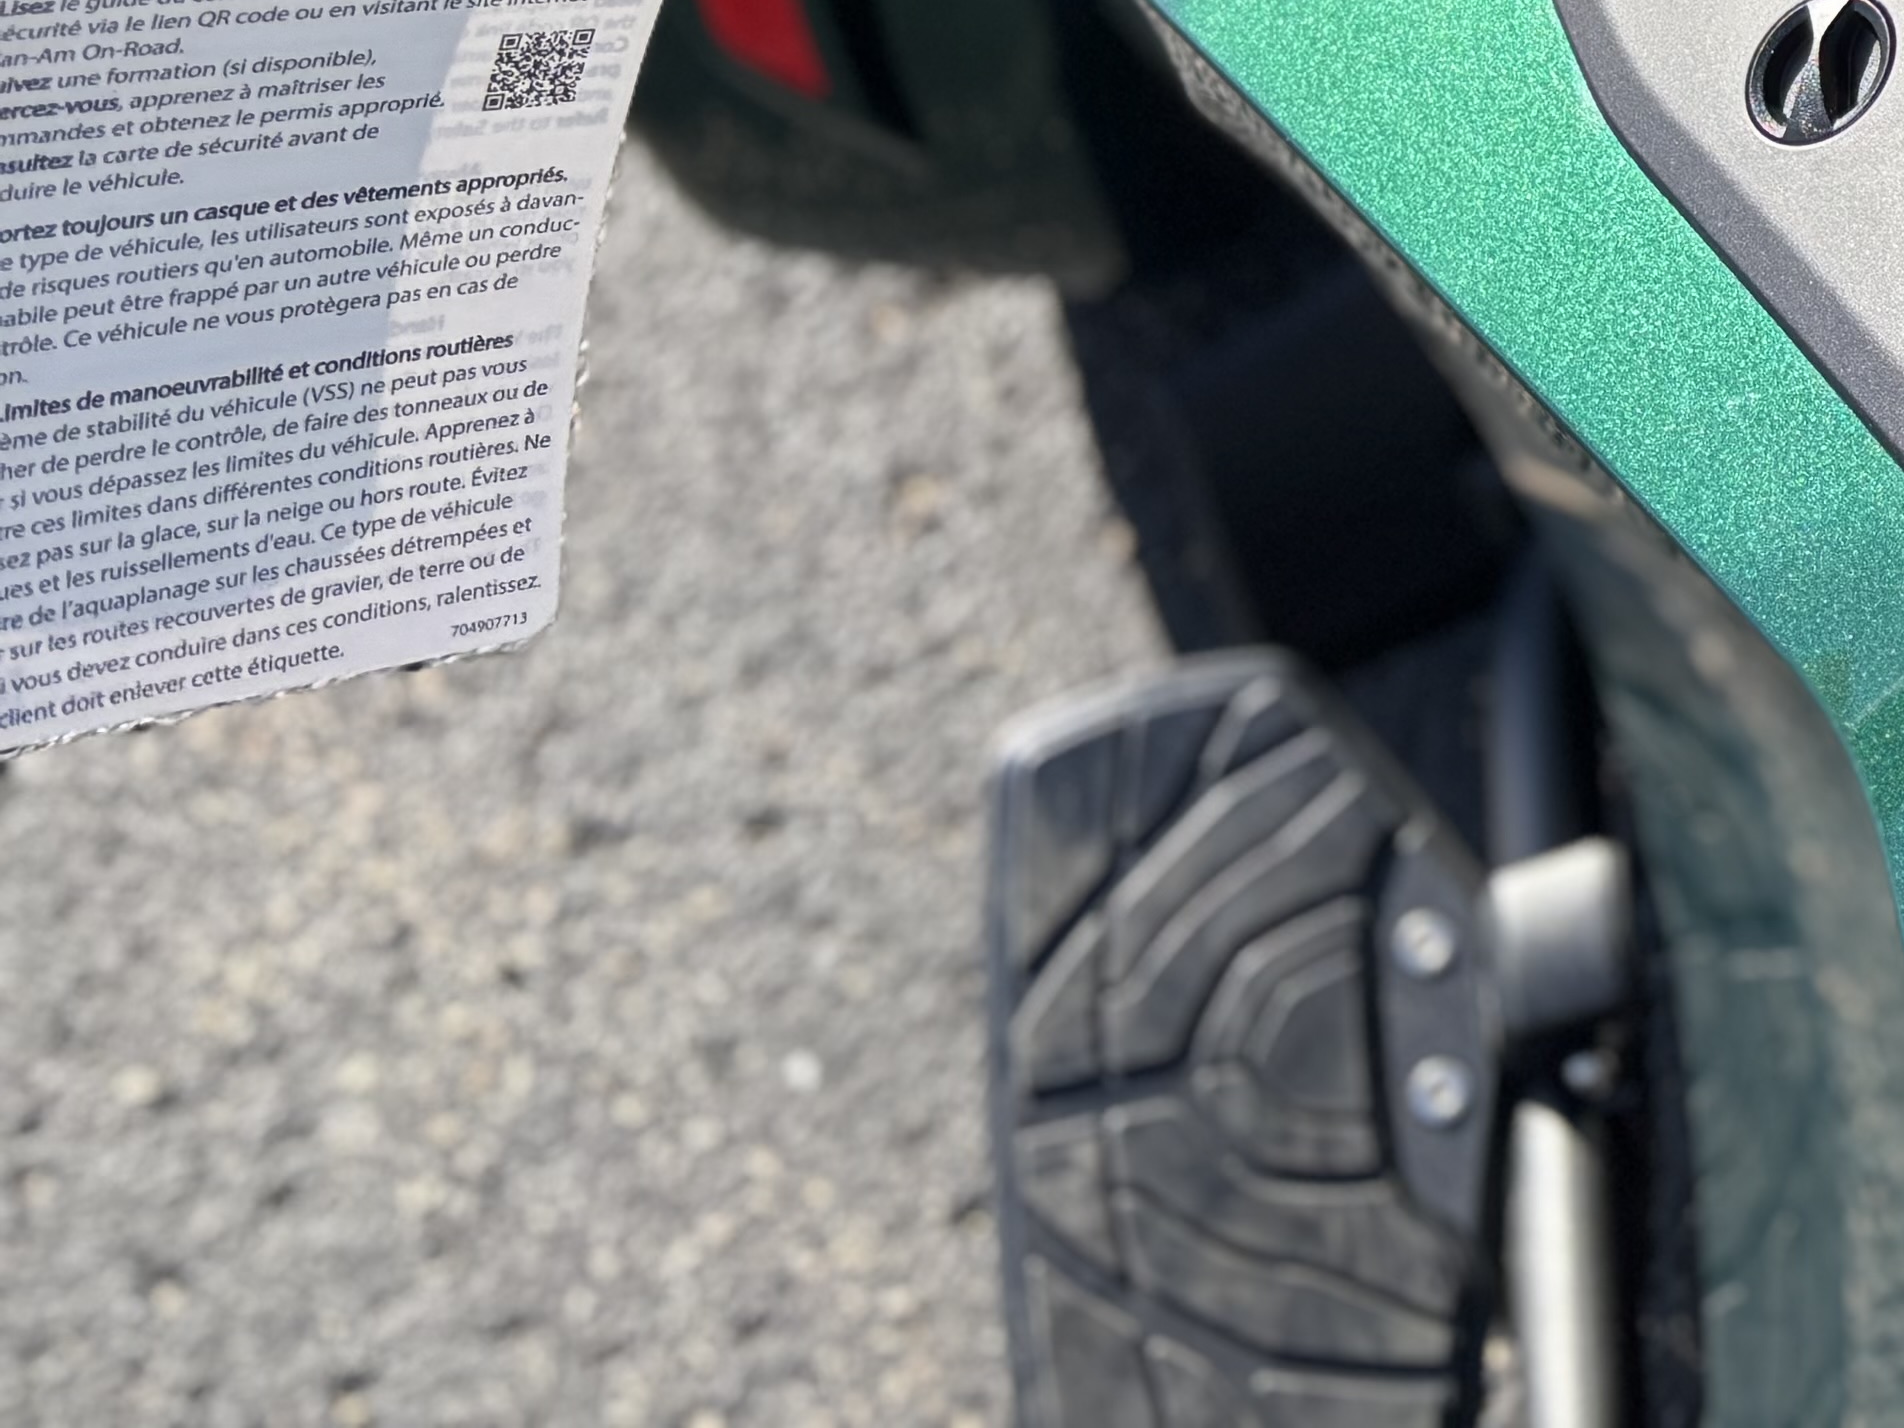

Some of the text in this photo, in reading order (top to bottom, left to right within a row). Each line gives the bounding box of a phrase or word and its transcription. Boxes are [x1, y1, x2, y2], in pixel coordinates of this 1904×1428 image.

[0, 0, 56, 18] Lisez
[87, 20, 119, 35] via
[150, 13, 192, 31] lien
[197, 9, 232, 28] QR
[235, 5, 290, 25] code
[57, 48, 377, 89] une formation disponible),
[82, 37, 184, 61] On-Road.
[129, 77, 353, 113] apprenez maîtriser
[139, 90, 445, 135] obtenez permis approprié.
[88, 168, 185, 193] véhicule.
[102, 126, 349, 164] carte sécurité avant
[19, 192, 585, 273] type véhicule, utilisateurs sont exposés davan-
[61, 212, 155, 238] toujours
[193, 200, 271, 222] casque
[300, 190, 340, 210] des
[343, 179, 452, 206] vêtements
[455, 165, 569, 197] appropriés.
[31, 273, 110, 296] risques
[116, 262, 199, 285] routiers
[269, 237, 394, 267] automobile.
[399, 230, 464, 251] Même
[499, 216, 581, 239] conduc-
[63, 242, 562, 325] peut être frappé par autre véhicule perdre
[1, 279, 489, 357] trôle. Ce véhicule vous protègera pas cas
[86, 359, 528, 439] stabilité véhicule (VSS) peut pas vous
[109, 334, 515, 407] manoeuvrabilité conditions routières
[31, 413, 521, 505] vous dépassez limites véhicule. Apprenez
[74, 391, 489, 475] perdre contrôle, faire des tonneaux
[30, 433, 552, 536] ces limites dans différentes conditions routières. Ne
[36, 465, 529, 570] pas sur glace, sur neige hors route. Évitez
[100, 541, 251, 583] ruissellements
[320, 522, 347, 542] Ce
[351, 516, 397, 540] type
[430, 492, 514, 522] véhicule
[215, 571, 248, 591] sur
[284, 545, 386, 577] chaussées
[390, 522, 508, 557] détrempées
[9, 559, 465, 661] sur routes recouvertes gravier, terre
[10, 575, 542, 693] vous devez conduire dans ces conditions, ralentissez.
[450, 611, 528, 638] 704907713
[61, 691, 106, 716] doit
[108, 676, 187, 706] enlever
[191, 664, 243, 688] cette
[247, 645, 345, 676] étiquette.
